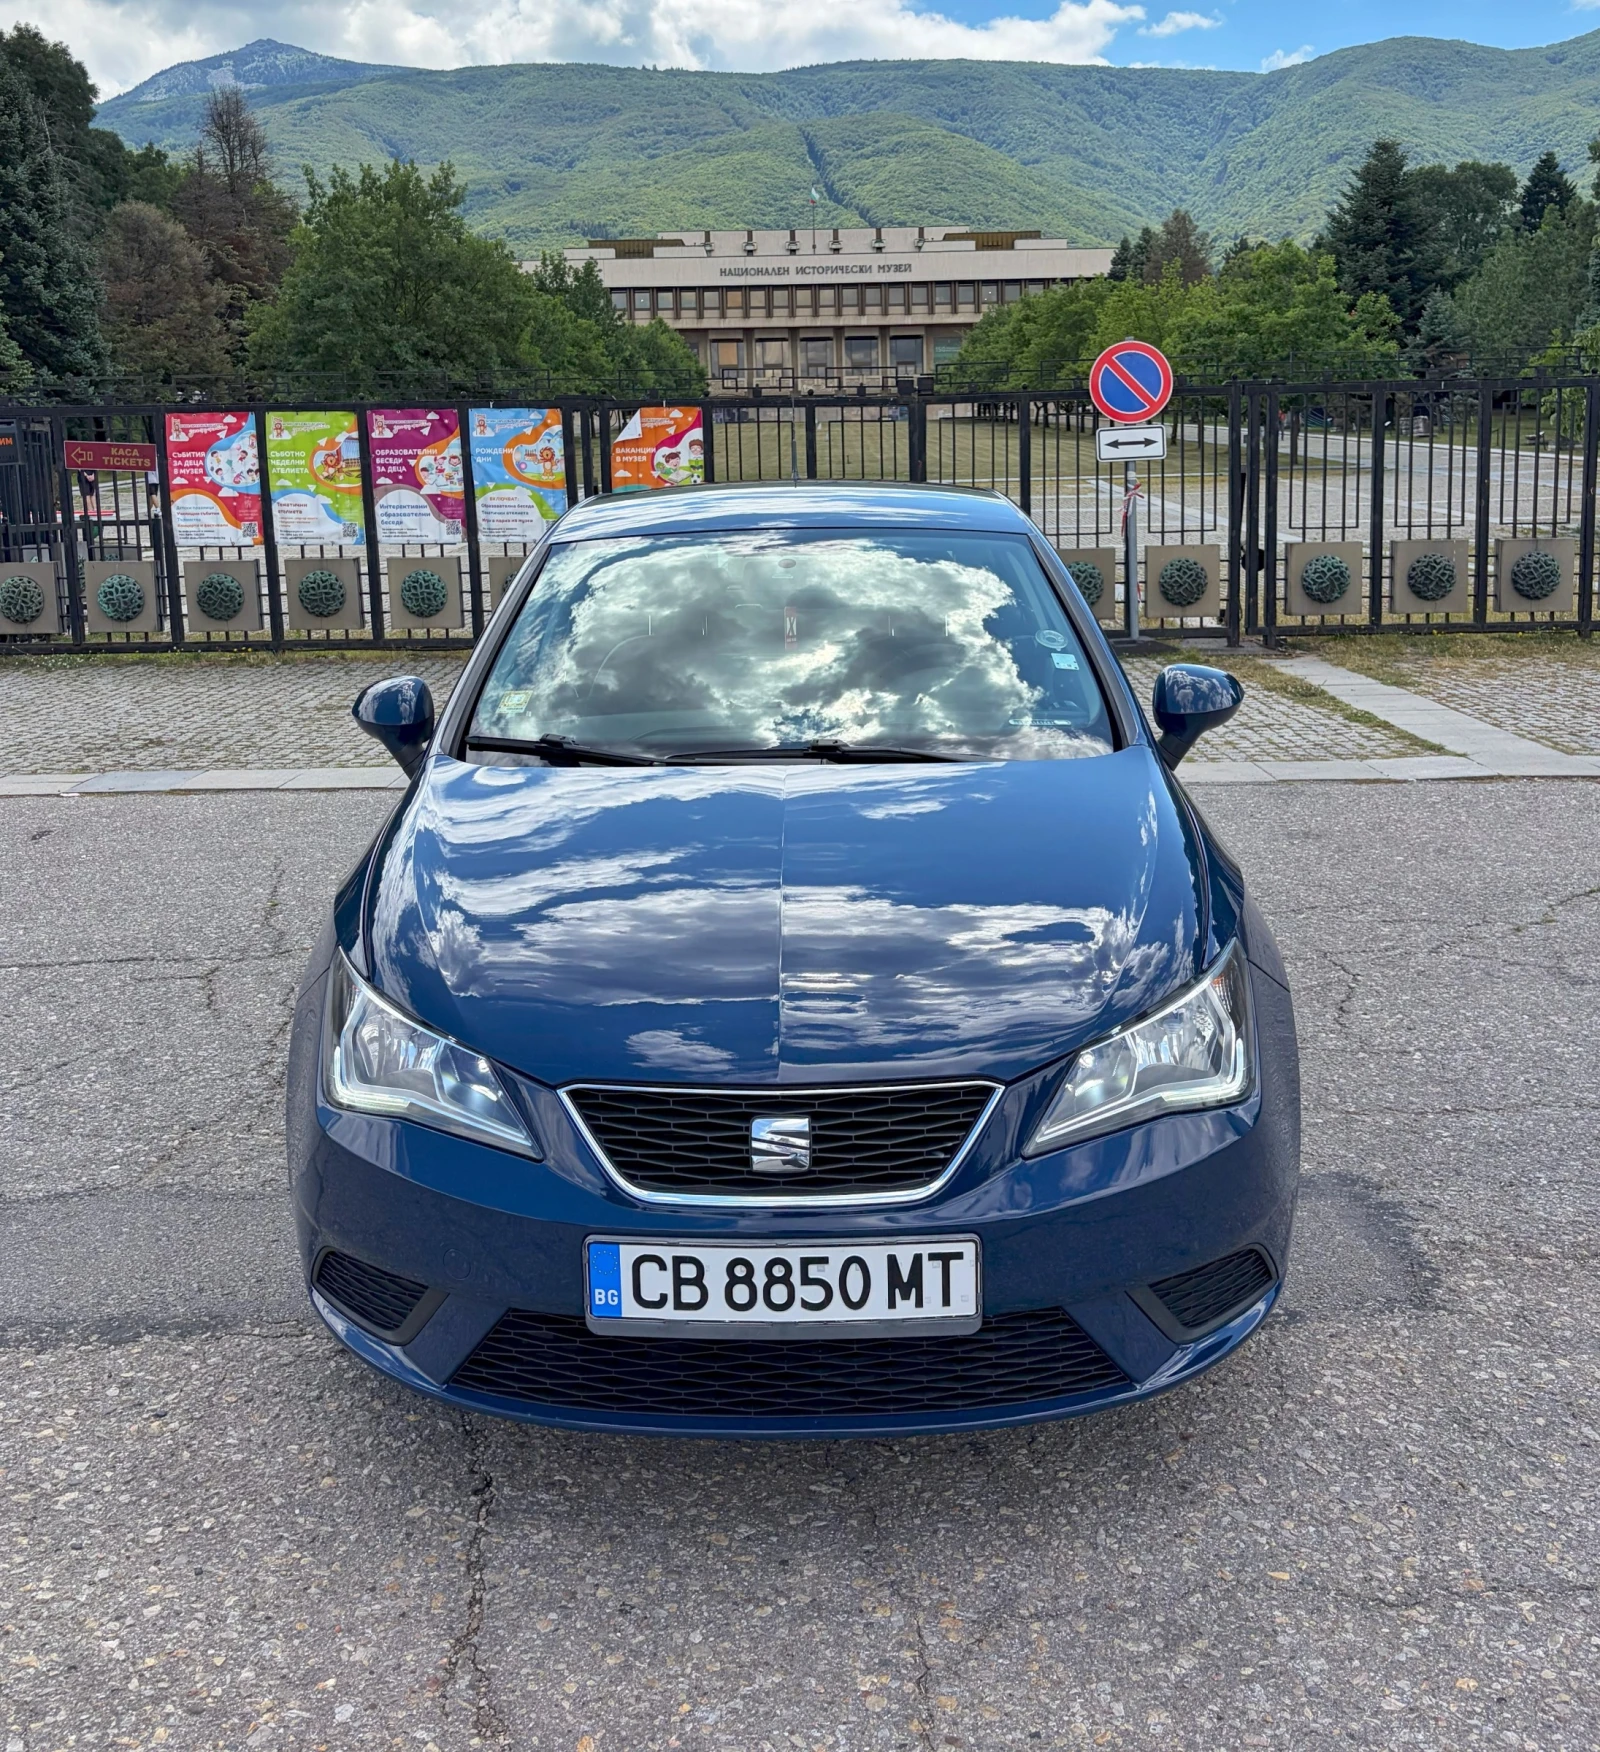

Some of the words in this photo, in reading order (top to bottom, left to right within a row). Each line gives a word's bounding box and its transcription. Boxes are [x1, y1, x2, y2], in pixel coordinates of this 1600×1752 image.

[719, 266, 790, 277] НАЦИОНАЛЕН
[795, 264, 873, 276] ИСТОРИЧЕСКИ
[877, 263, 912, 274] МУЗЕЙ
[111, 447, 140, 457] КАСА
[375, 448, 438, 456] ОБРАЗОВАТЕЛНИ
[475, 447, 514, 455] РОЖДЕНИ
[102, 456, 151, 467] TICKETS
[172, 459, 183, 467] ЗА
[184, 459, 204, 468] ДЕЦА
[631, 1253, 709, 1311] CB
[723, 1256, 871, 1312] 8850
[886, 1251, 964, 1310] MT
[594, 1288, 619, 1307] BG
